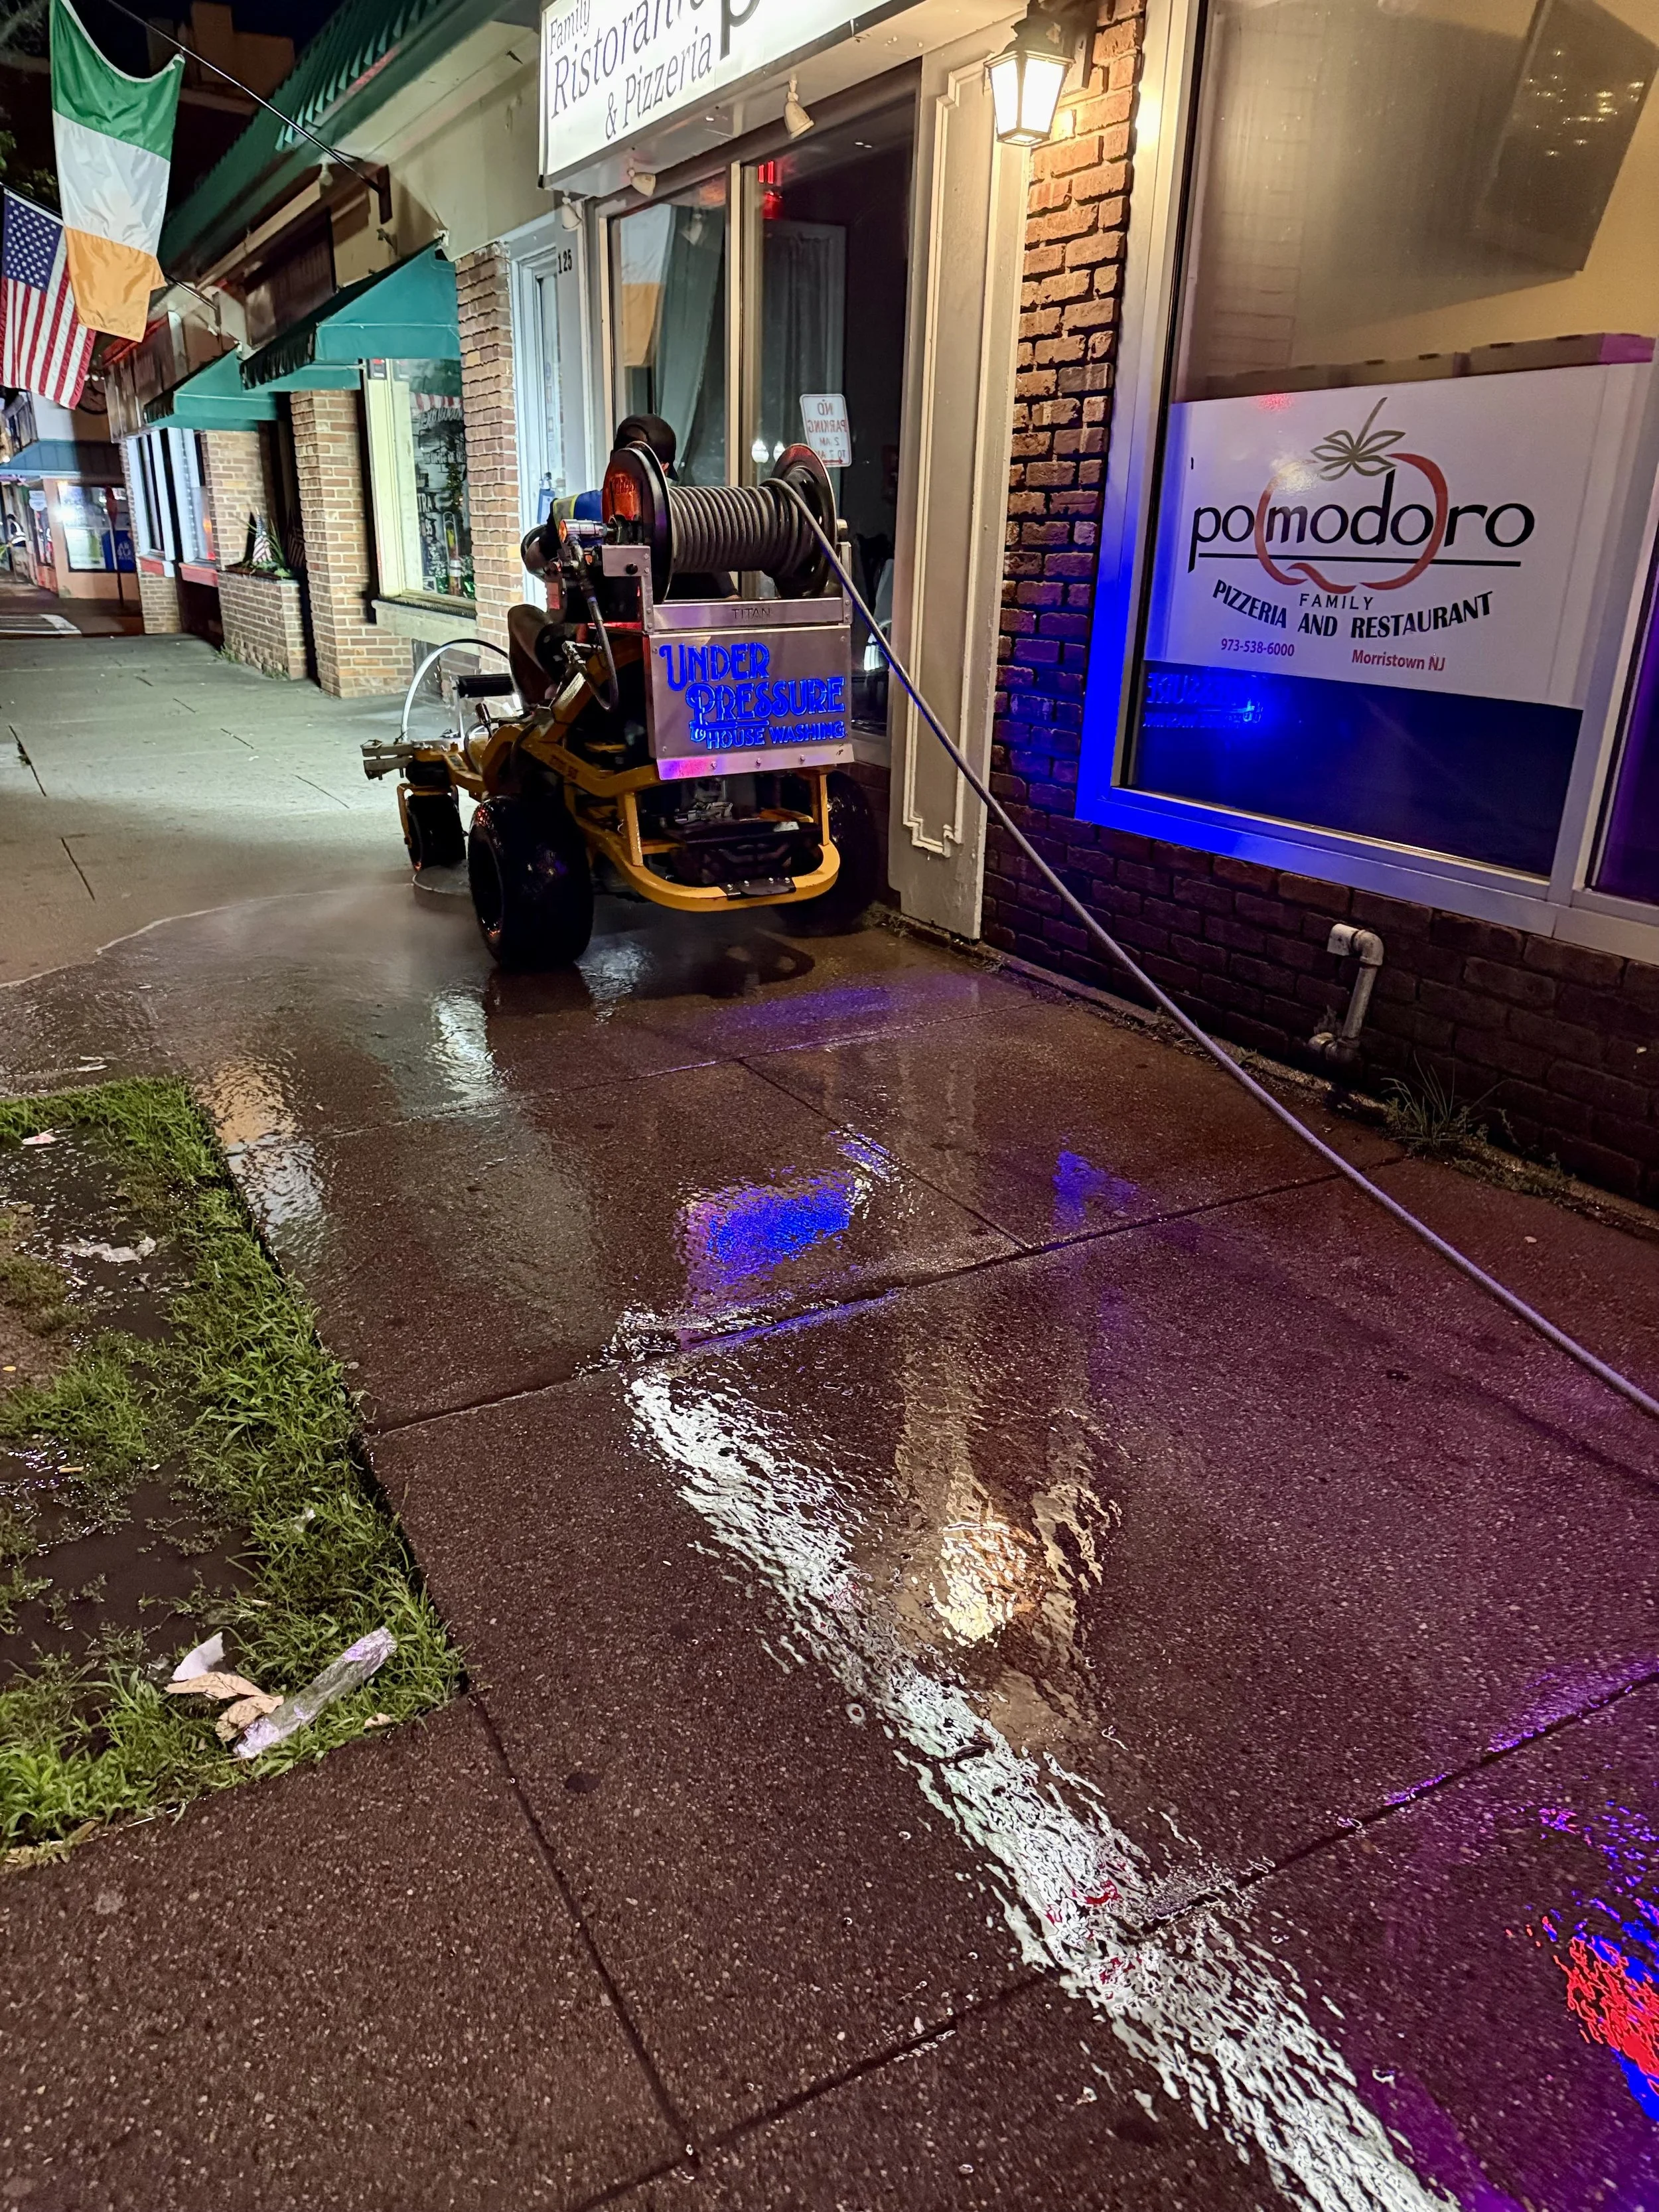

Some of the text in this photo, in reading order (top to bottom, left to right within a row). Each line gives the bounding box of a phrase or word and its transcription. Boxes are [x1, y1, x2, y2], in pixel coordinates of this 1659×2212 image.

[550, 0, 590, 56] Family
[551, 0, 703, 119] Ristoran
[605, 25, 711, 140] & Pizzeria
[558, 249, 572, 274] 125
[1188, 469, 1535, 573] pomodoro
[731, 607, 771, 620] TITAN
[1212, 579, 1493, 638] PIZZERIA AND RESTAURANT
[1299, 593, 1374, 611] FAMILY
[659, 642, 770, 691] UNDER
[1220, 637, 1295, 657] 973-538-6000
[1352, 649, 1445, 672] Morristown NJ
[685, 677, 845, 725] PRESSURE
[707, 721, 845, 751] HOUSE WASHING
